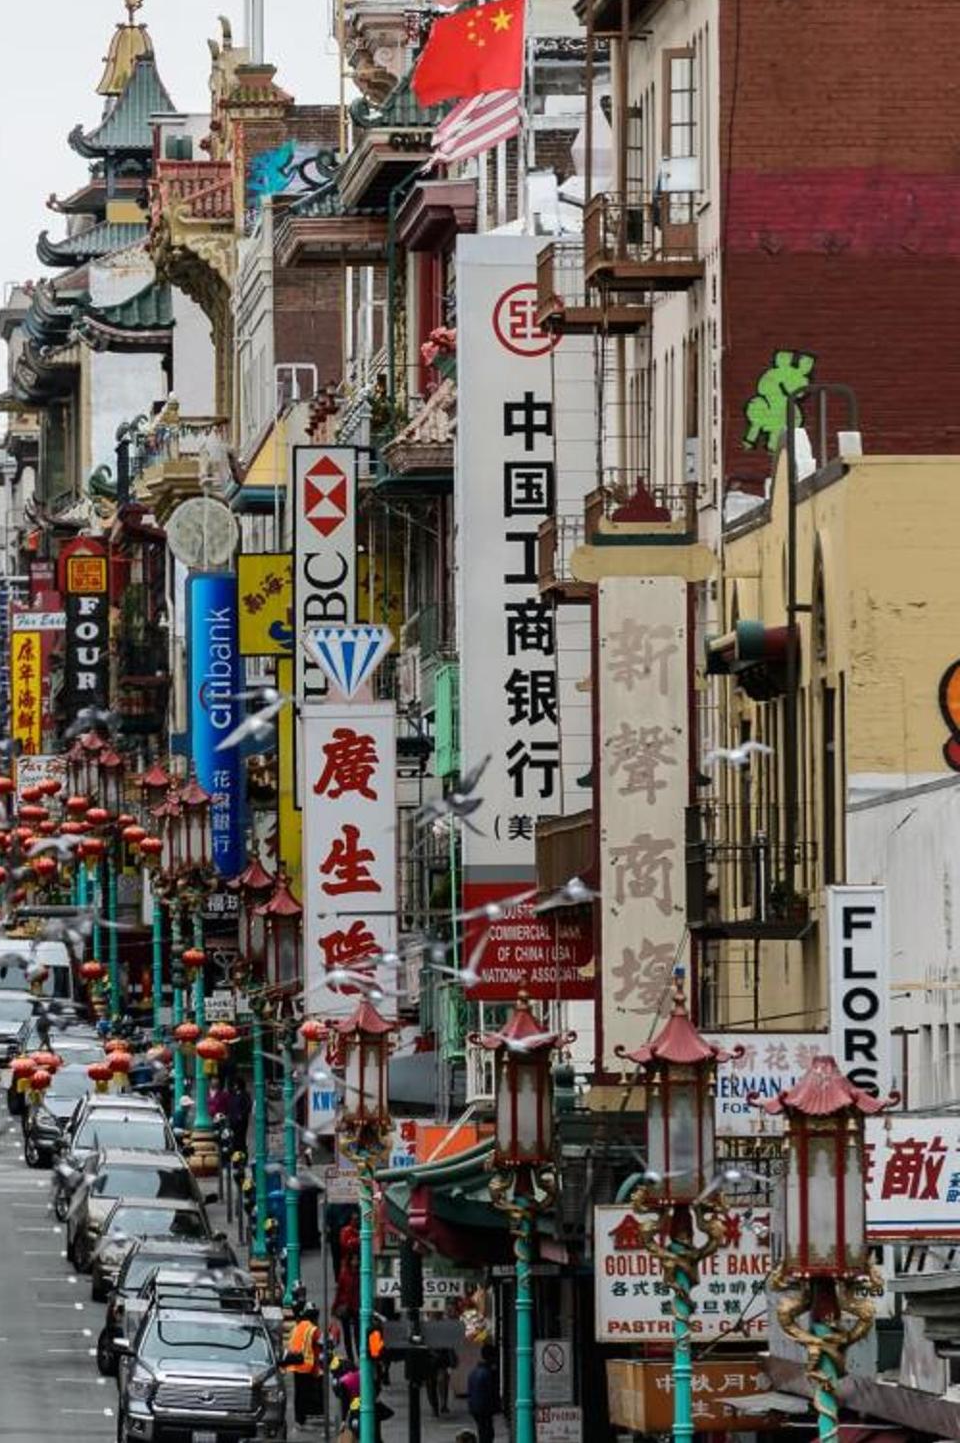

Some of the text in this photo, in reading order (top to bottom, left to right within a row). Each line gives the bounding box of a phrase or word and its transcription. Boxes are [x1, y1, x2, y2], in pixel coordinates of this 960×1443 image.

[502, 391, 559, 799] 中国工商银行
[303, 550, 349, 700] HBC
[74, 596, 101, 690] FOUR
[202, 606, 232, 729] citibank
[489, 925, 552, 941] COMMERCIAL
[497, 946, 511, 962] OF
[841, 906, 881, 1099] FLORS
[727, 1255, 771, 1276] BAKE
[379, 1280, 460, 1293] JASON
[607, 1320, 703, 1334] PASTRIS
[656, 1373, 760, 1394] 中秋月
